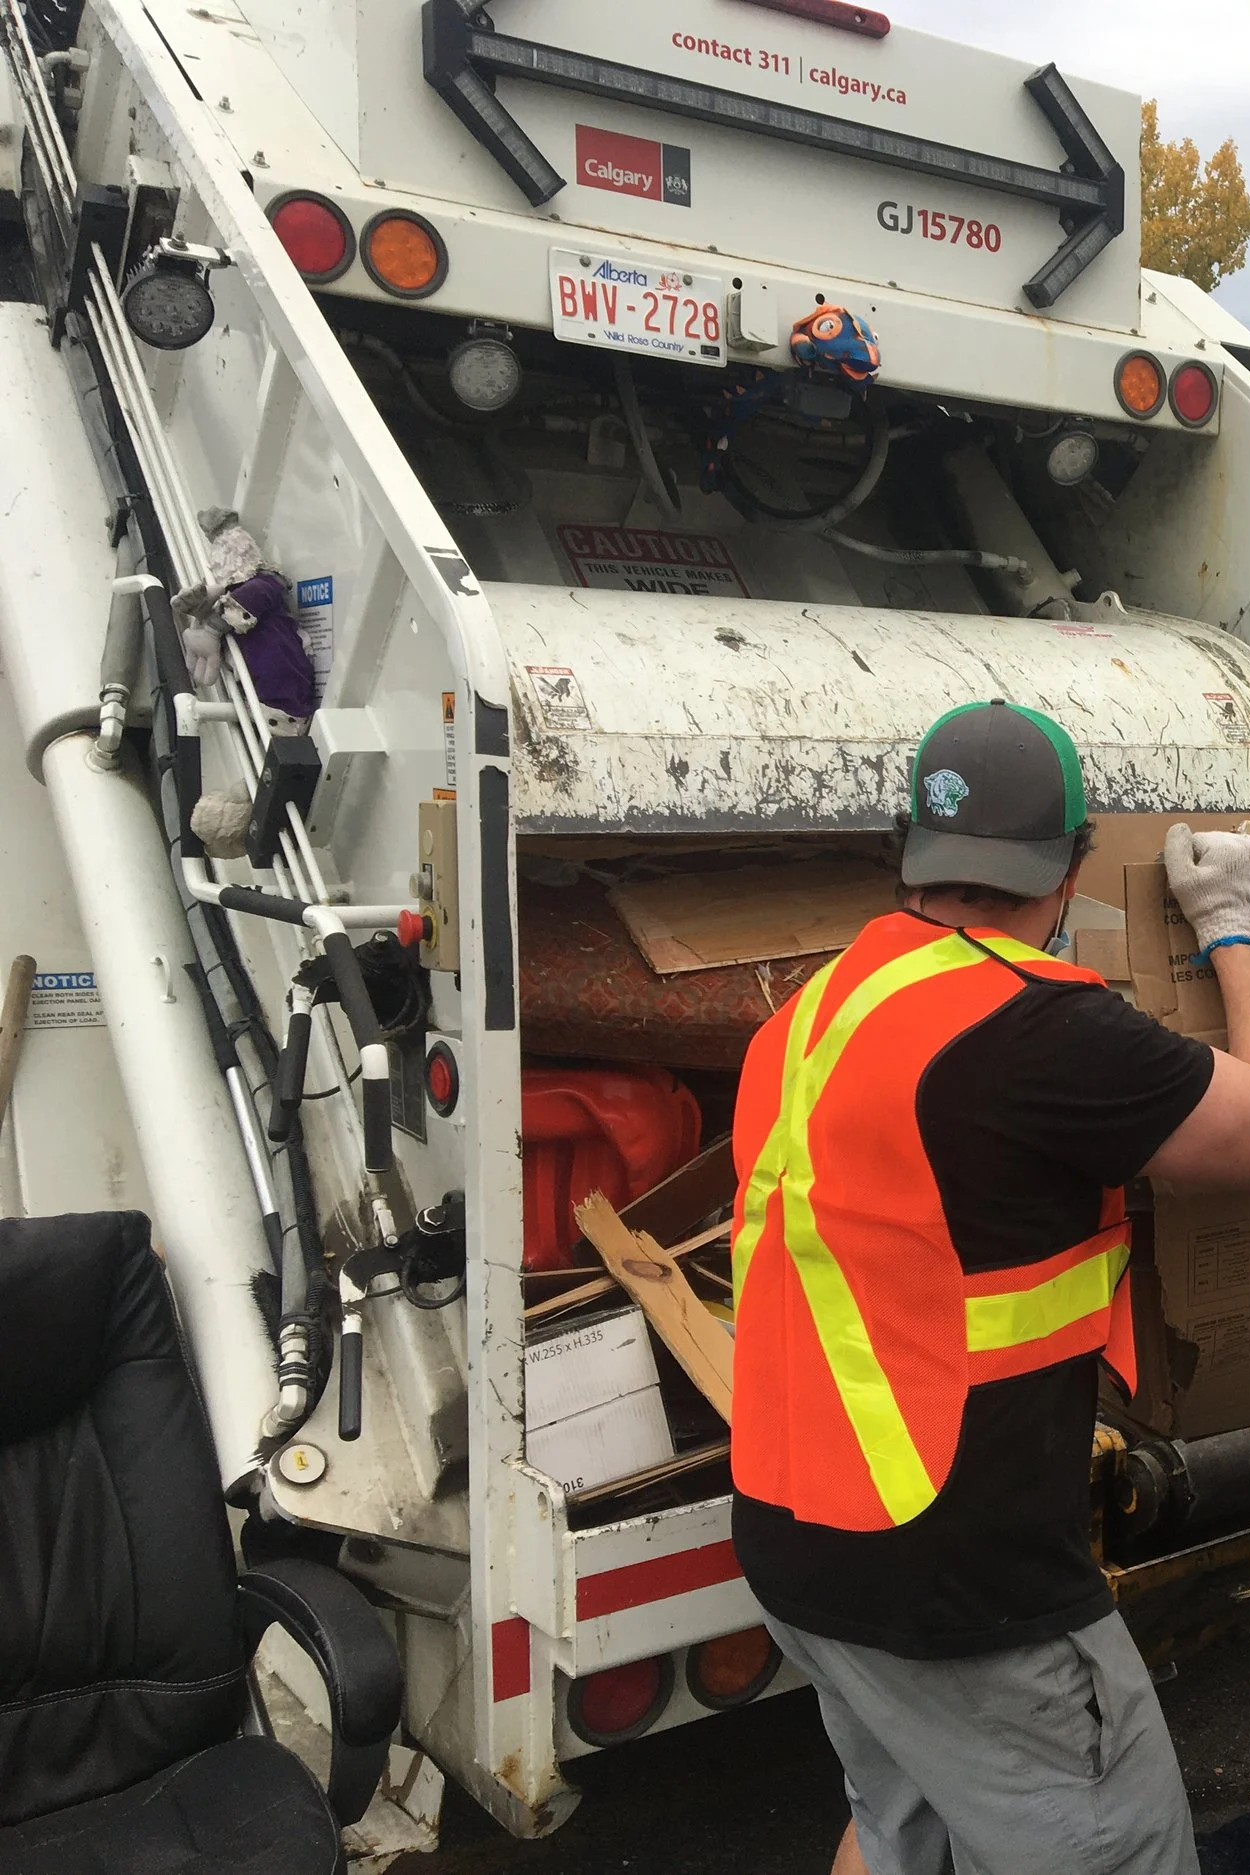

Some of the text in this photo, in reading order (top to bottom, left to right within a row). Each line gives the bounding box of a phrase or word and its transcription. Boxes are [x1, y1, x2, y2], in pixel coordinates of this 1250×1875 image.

[672, 32, 907, 104] contact 311 calgary.ca
[584, 159, 653, 191] Calgary
[877, 201, 1001, 252] GJ15780
[592, 260, 648, 287] Alberta
[559, 275, 719, 342] BWV-2728
[603, 330, 684, 352] Wild Rose Country
[563, 529, 728, 565] CAUTION
[584, 563, 732, 582] THIS VEHICLE MAKES
[301, 582, 329, 603] NOTICE
[32, 975, 97, 988] NOTIC
[1171, 971, 1193, 983] LES
[529, 1344, 563, 1363] W.255
[565, 1342, 572, 1352] x
[573, 1330, 603, 1349] H.335
